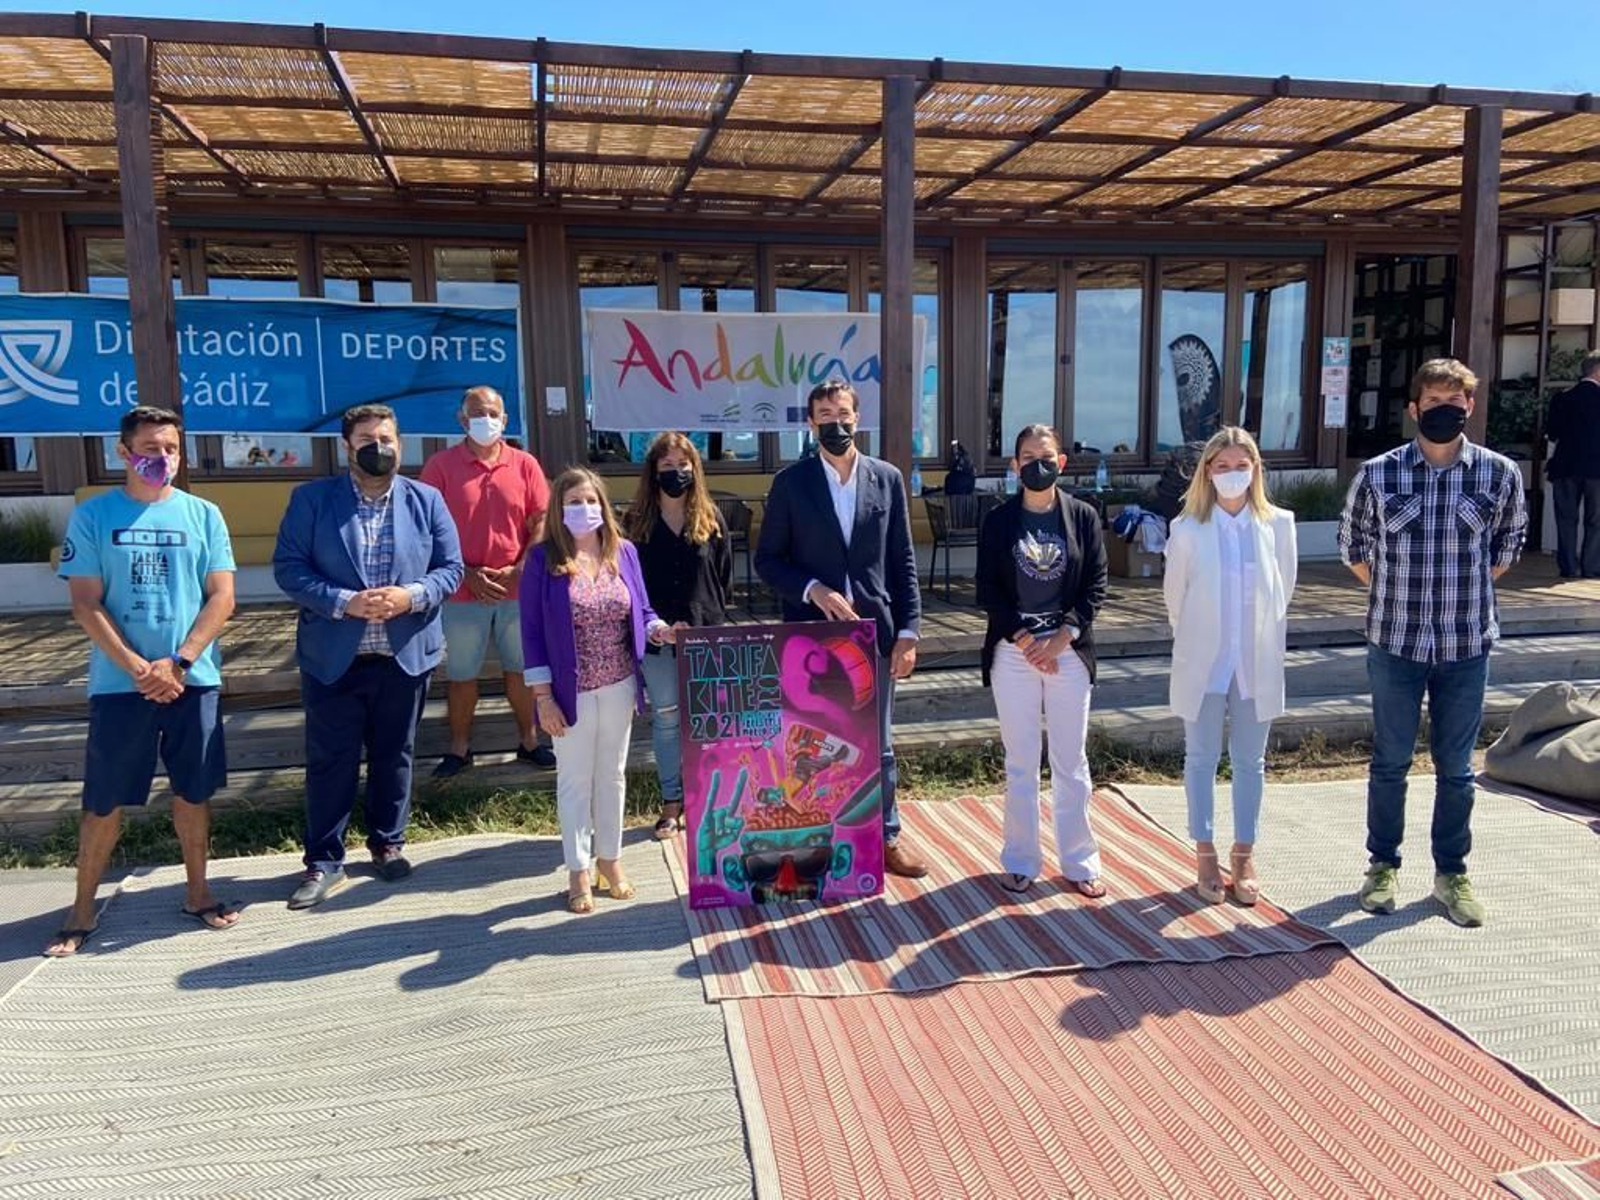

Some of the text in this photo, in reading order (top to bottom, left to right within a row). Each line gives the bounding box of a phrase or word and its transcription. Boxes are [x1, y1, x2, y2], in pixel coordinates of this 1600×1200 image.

[341, 332, 507, 363] DEPORTES
[612, 318, 881, 394] Andalucía
[684, 644, 780, 680] TARIFA
[687, 677, 757, 715] KITE
[690, 713, 741, 741] 2021
